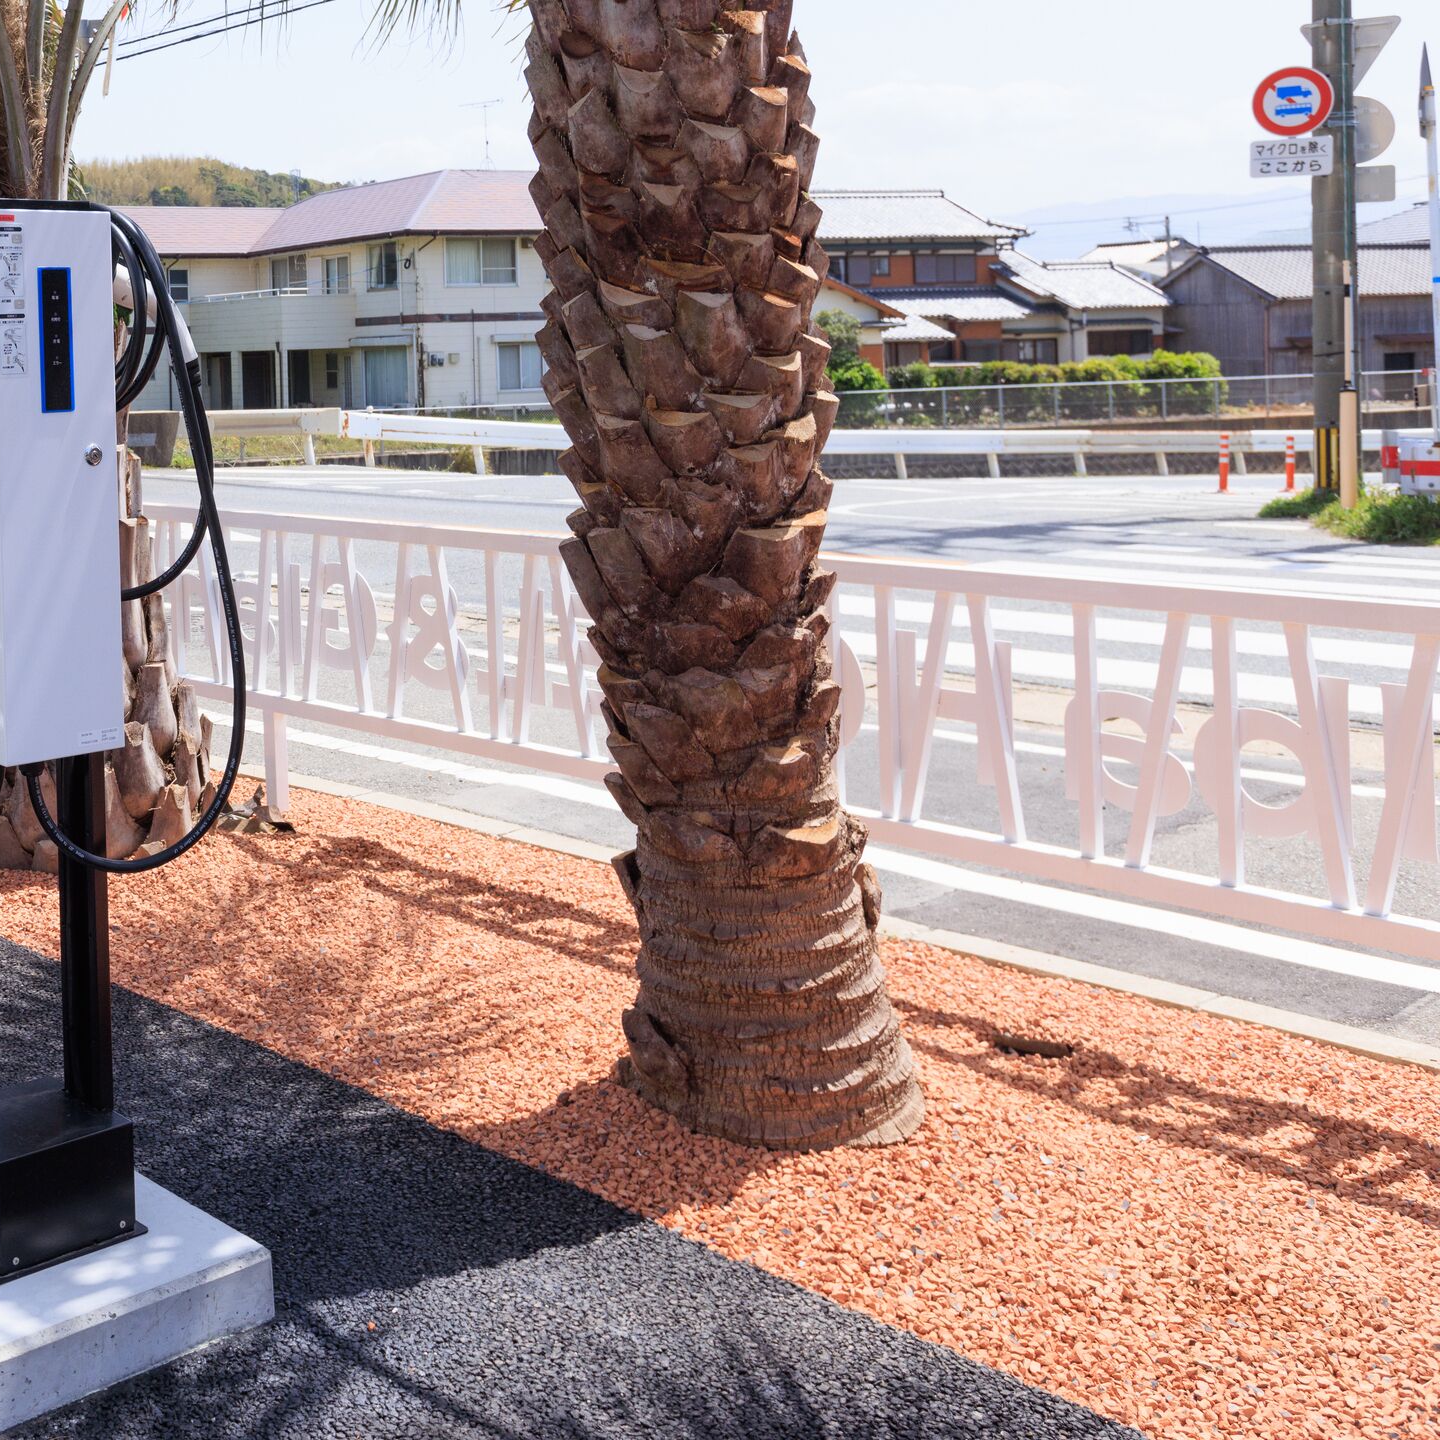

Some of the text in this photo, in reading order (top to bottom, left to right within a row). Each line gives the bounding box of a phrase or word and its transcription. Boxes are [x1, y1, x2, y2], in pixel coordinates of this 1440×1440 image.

[1256, 141, 1327, 155] マイクロを除く
[1260, 161, 1322, 173] ここから
